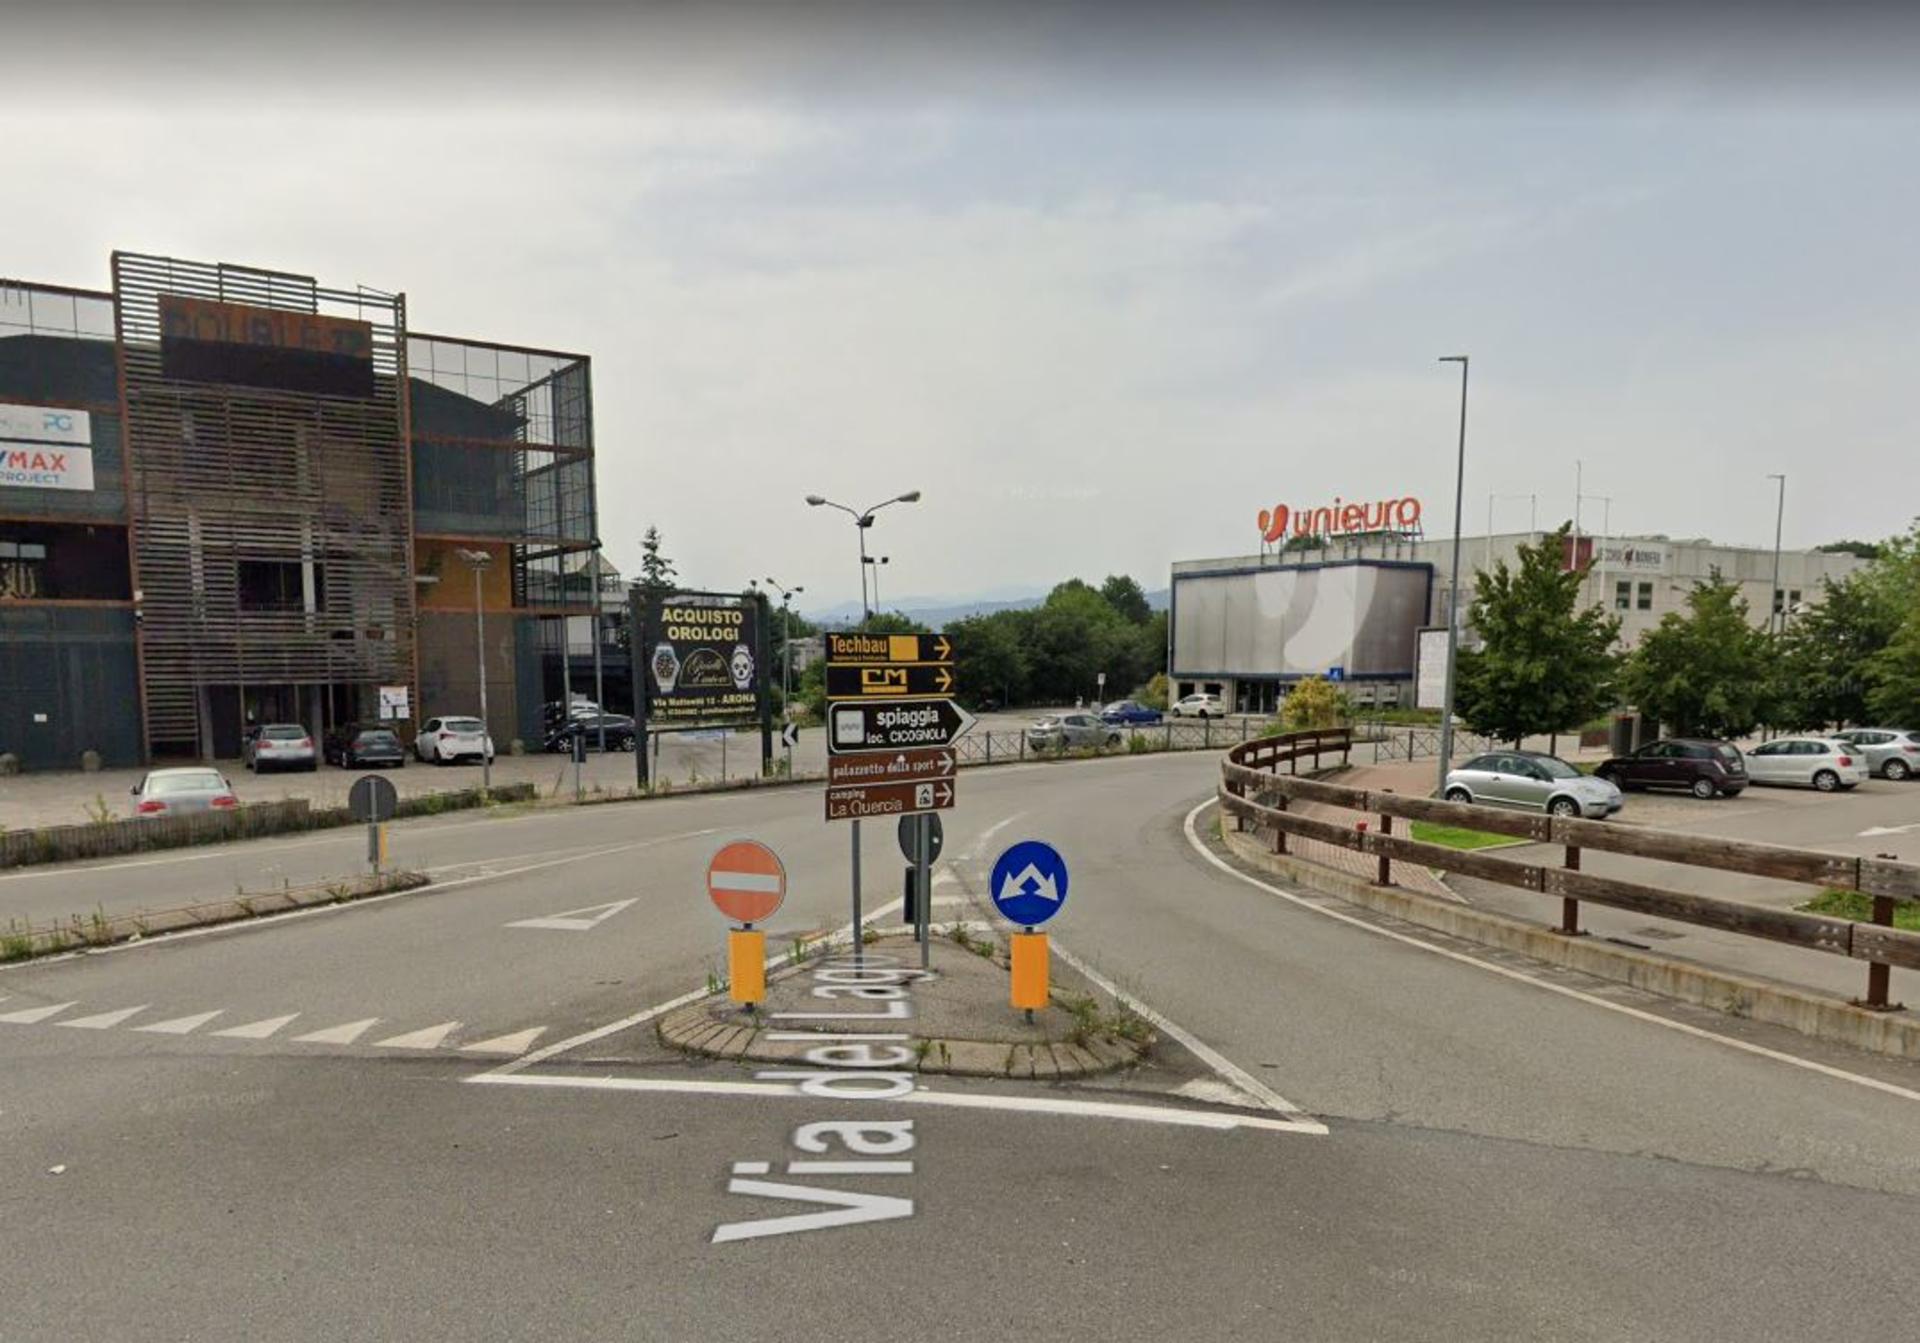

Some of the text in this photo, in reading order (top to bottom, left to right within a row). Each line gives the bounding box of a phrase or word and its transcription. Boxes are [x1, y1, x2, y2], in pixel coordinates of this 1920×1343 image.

[1294, 497, 1421, 535] unieuro
[661, 608, 743, 625] ACQUISTO
[667, 626, 740, 641] OROLOGI
[830, 634, 888, 654] Techbau
[861, 668, 908, 686] CM
[876, 706, 940, 729] spiaggia
[889, 727, 948, 743] CICOGNOLA
[829, 788, 866, 801] camping
[829, 799, 903, 818] La Quercia
